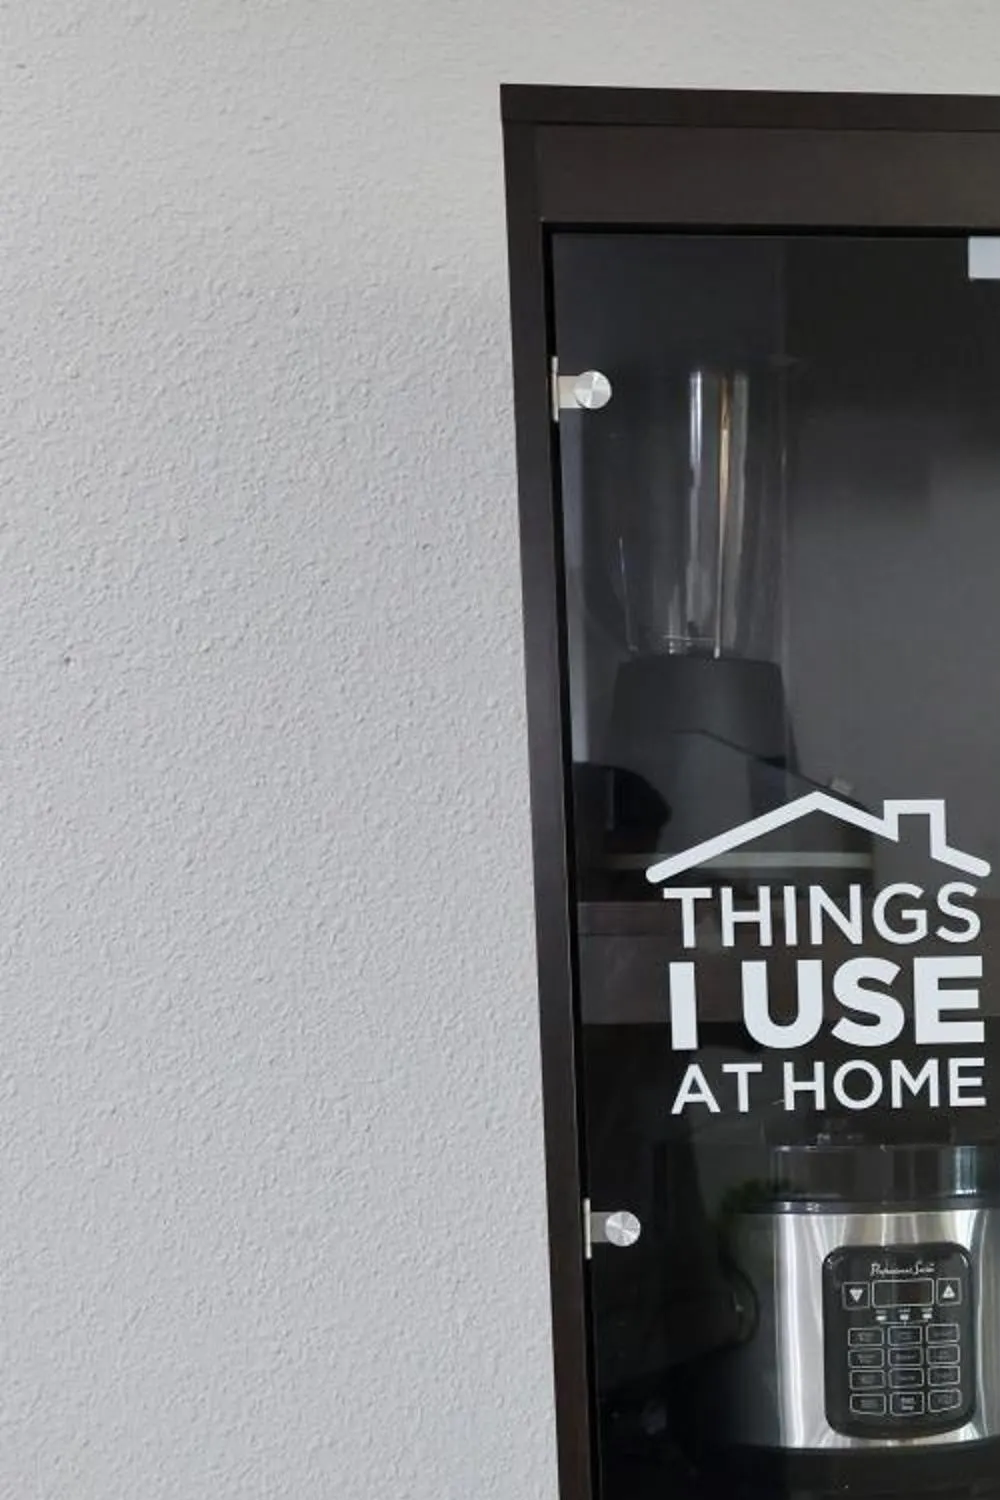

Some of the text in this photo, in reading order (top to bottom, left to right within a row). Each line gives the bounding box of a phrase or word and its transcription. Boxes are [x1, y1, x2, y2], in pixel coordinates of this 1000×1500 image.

[662, 882, 982, 948] THINGS
[669, 955, 986, 1050] I USE
[671, 1057, 987, 1115] AT HOME
